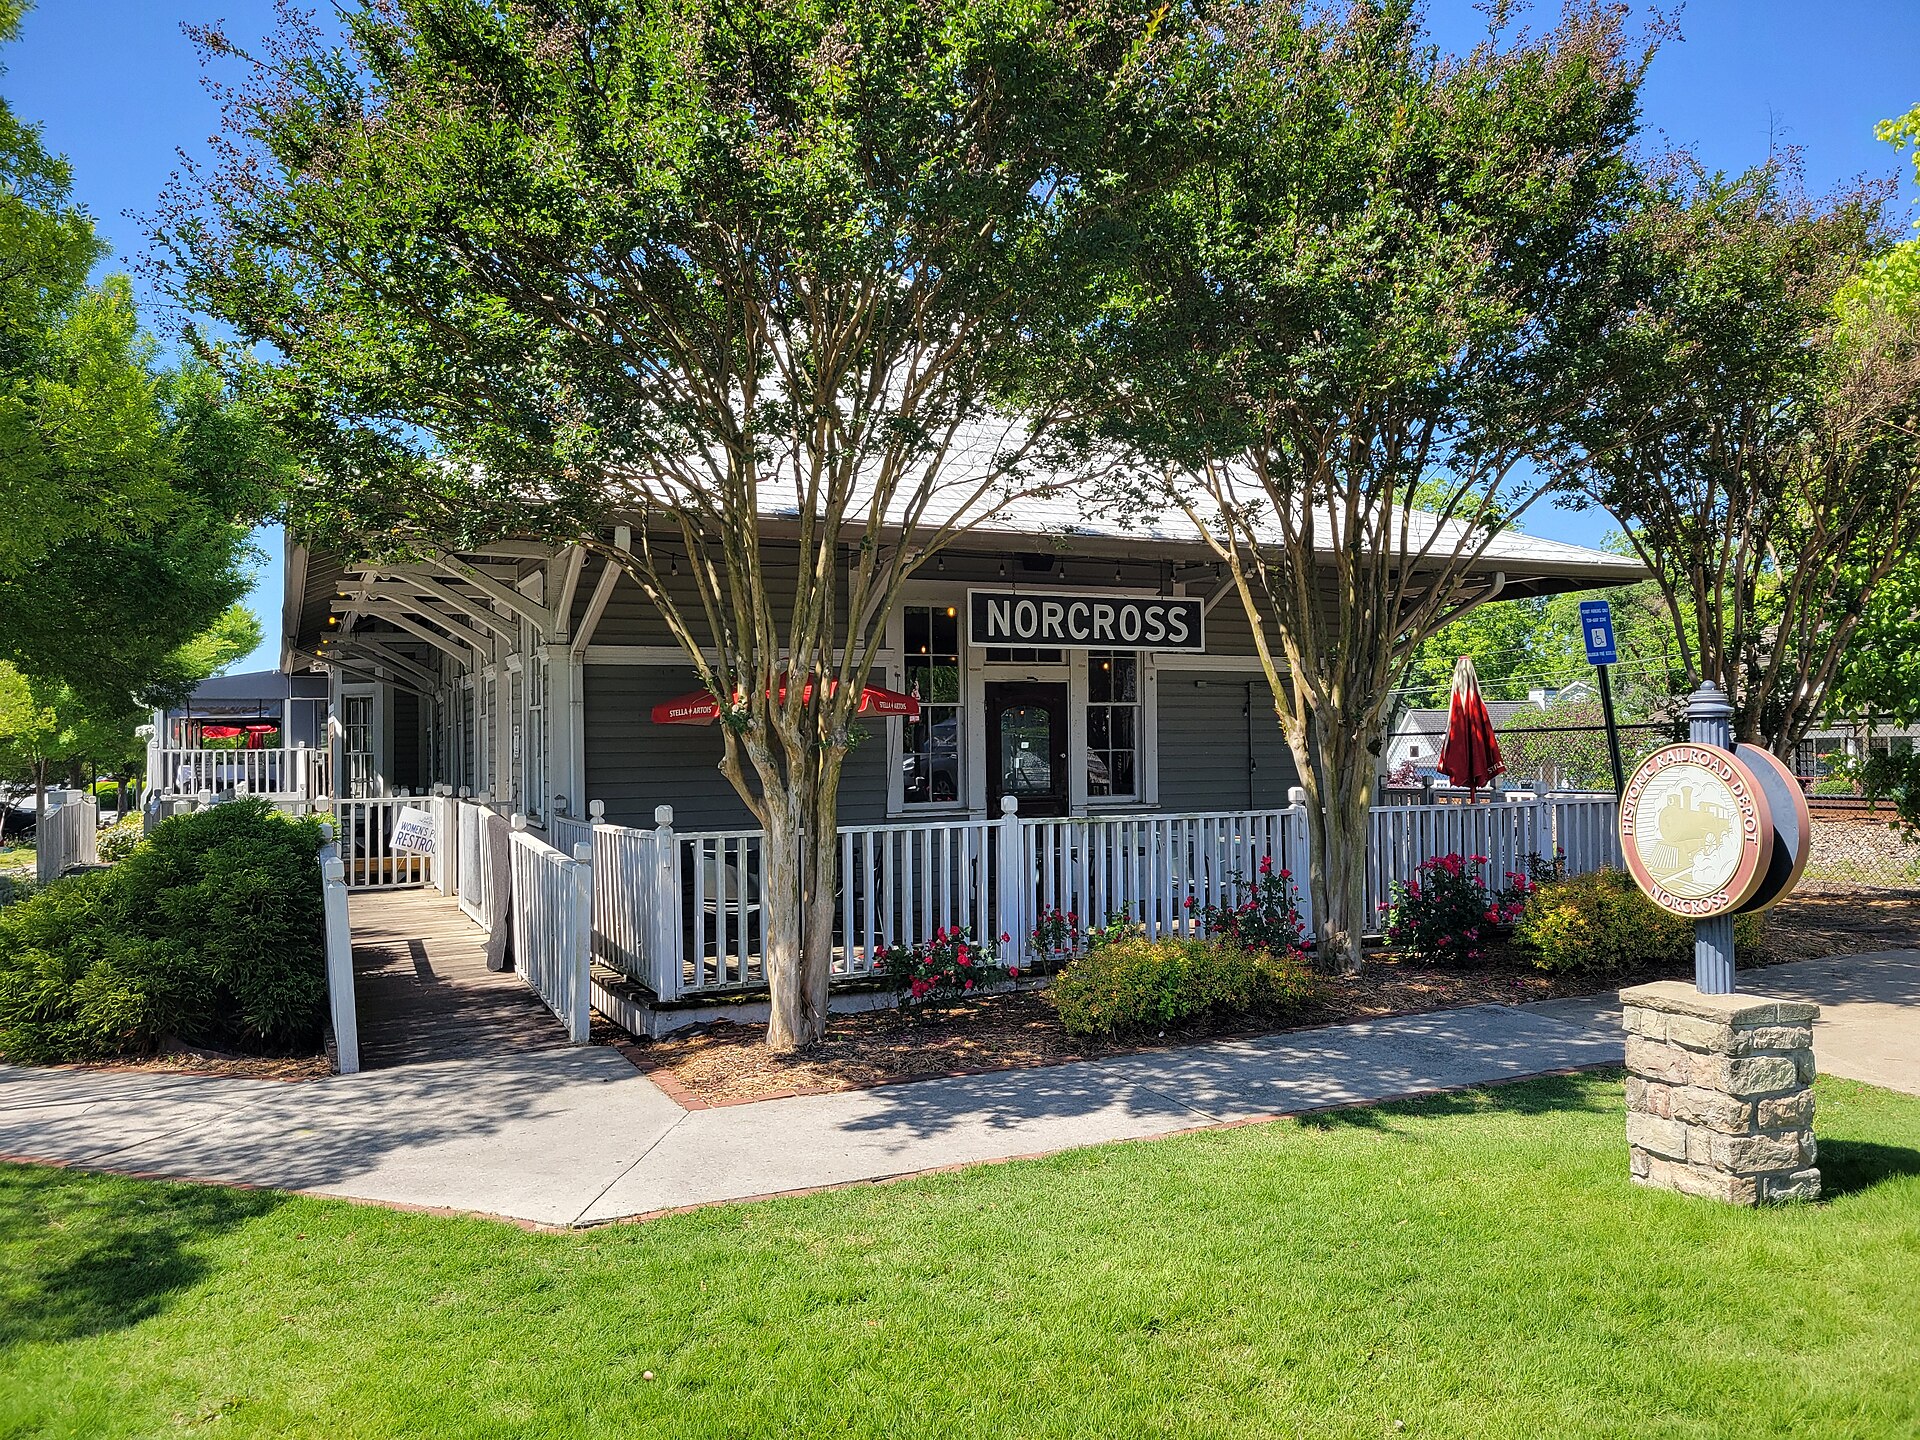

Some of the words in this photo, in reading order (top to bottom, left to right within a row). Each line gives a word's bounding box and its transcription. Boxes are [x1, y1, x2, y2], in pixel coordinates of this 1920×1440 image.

[987, 600, 1189, 643] NORCROSS
[670, 708, 688, 717] STELLA
[693, 706, 712, 714] ARTOIS
[1623, 763, 1656, 836] HISTORIC
[1656, 748, 1733, 782] RAILROAD
[1731, 781, 1759, 846] DEPOT
[401, 821, 429, 836] WOMEN'S
[1650, 884, 1729, 915] NORCROSS
